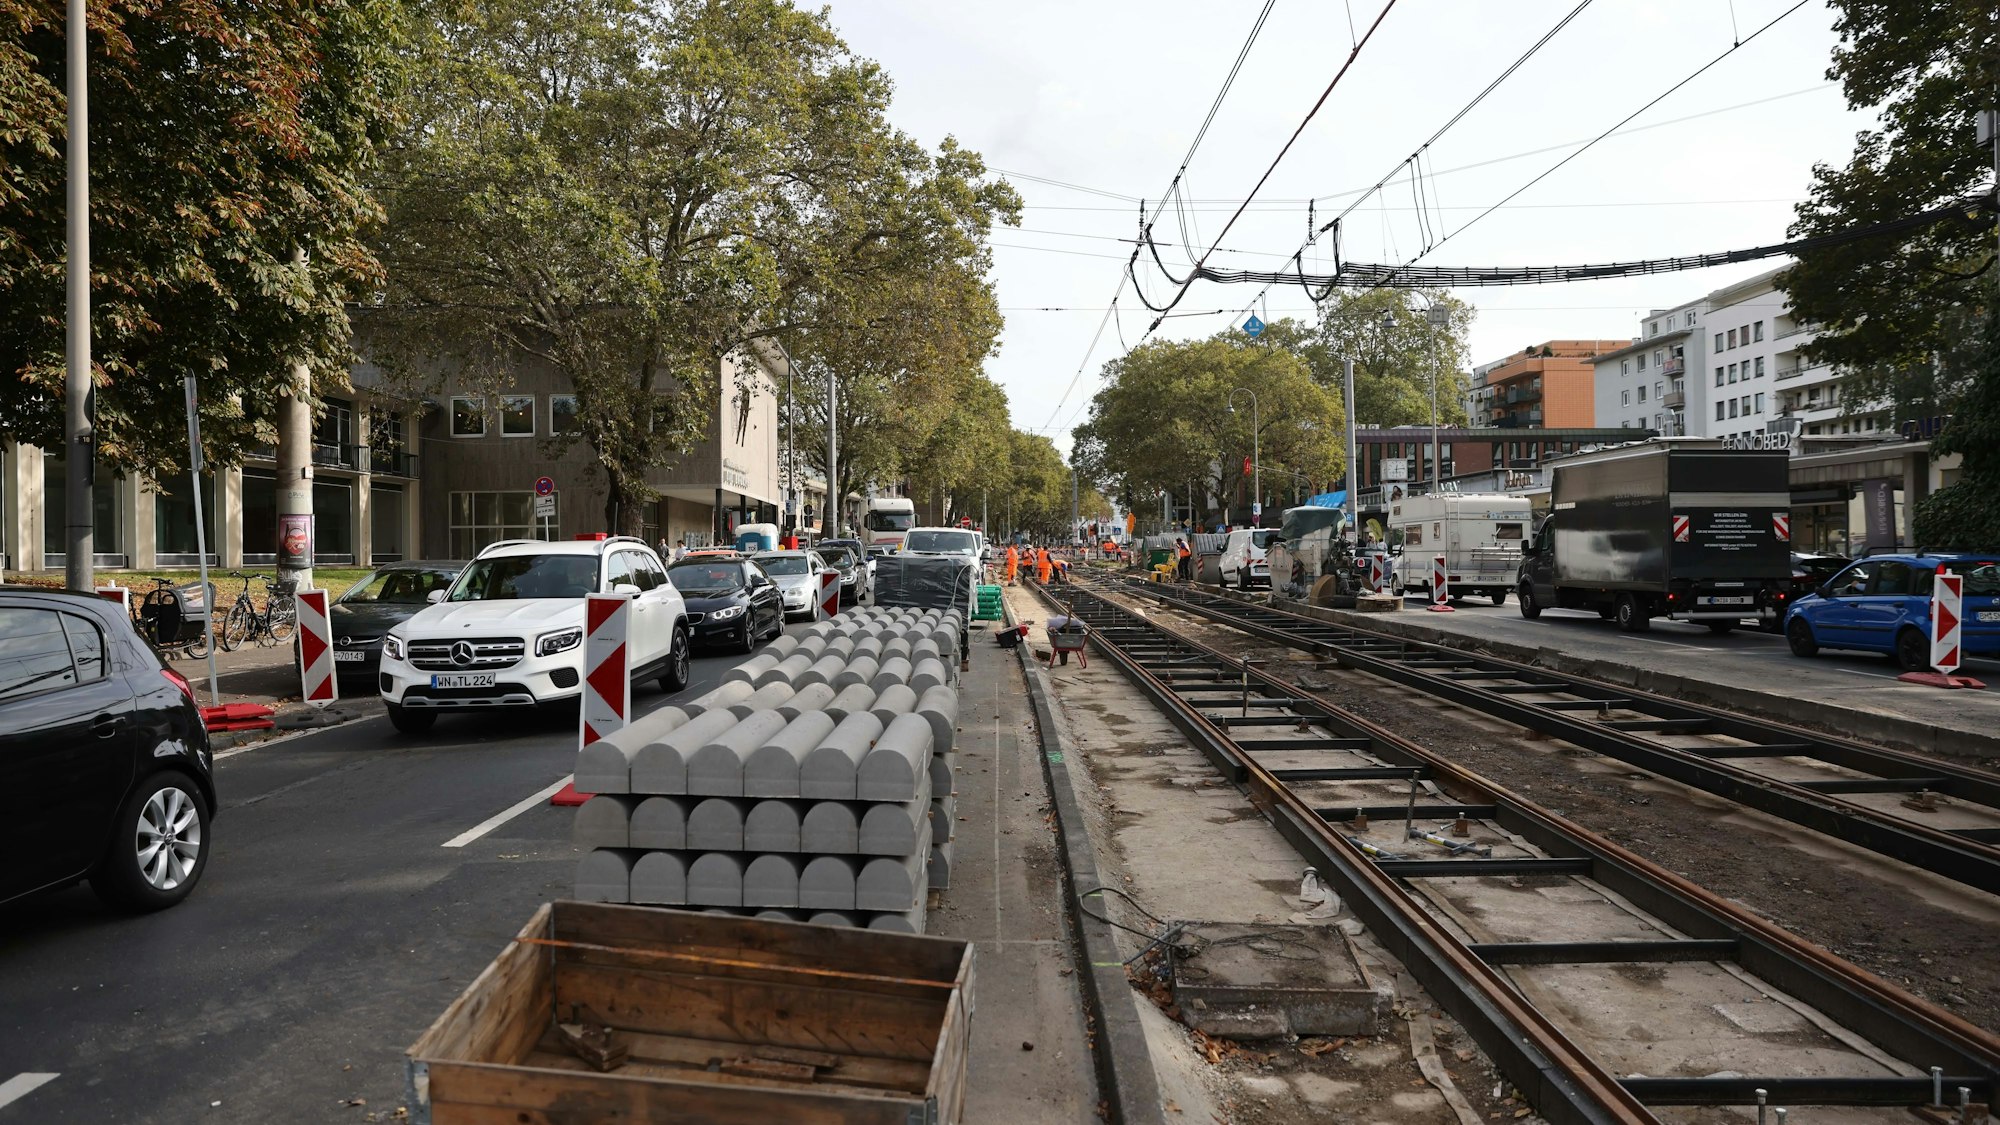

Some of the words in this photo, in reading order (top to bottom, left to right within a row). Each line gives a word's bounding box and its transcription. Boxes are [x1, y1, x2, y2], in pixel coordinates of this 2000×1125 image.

[1722, 431, 1789, 450] FENNOBED
[437, 676, 451, 687] WN
[457, 676, 471, 686] TL
[473, 675, 493, 686] 224
